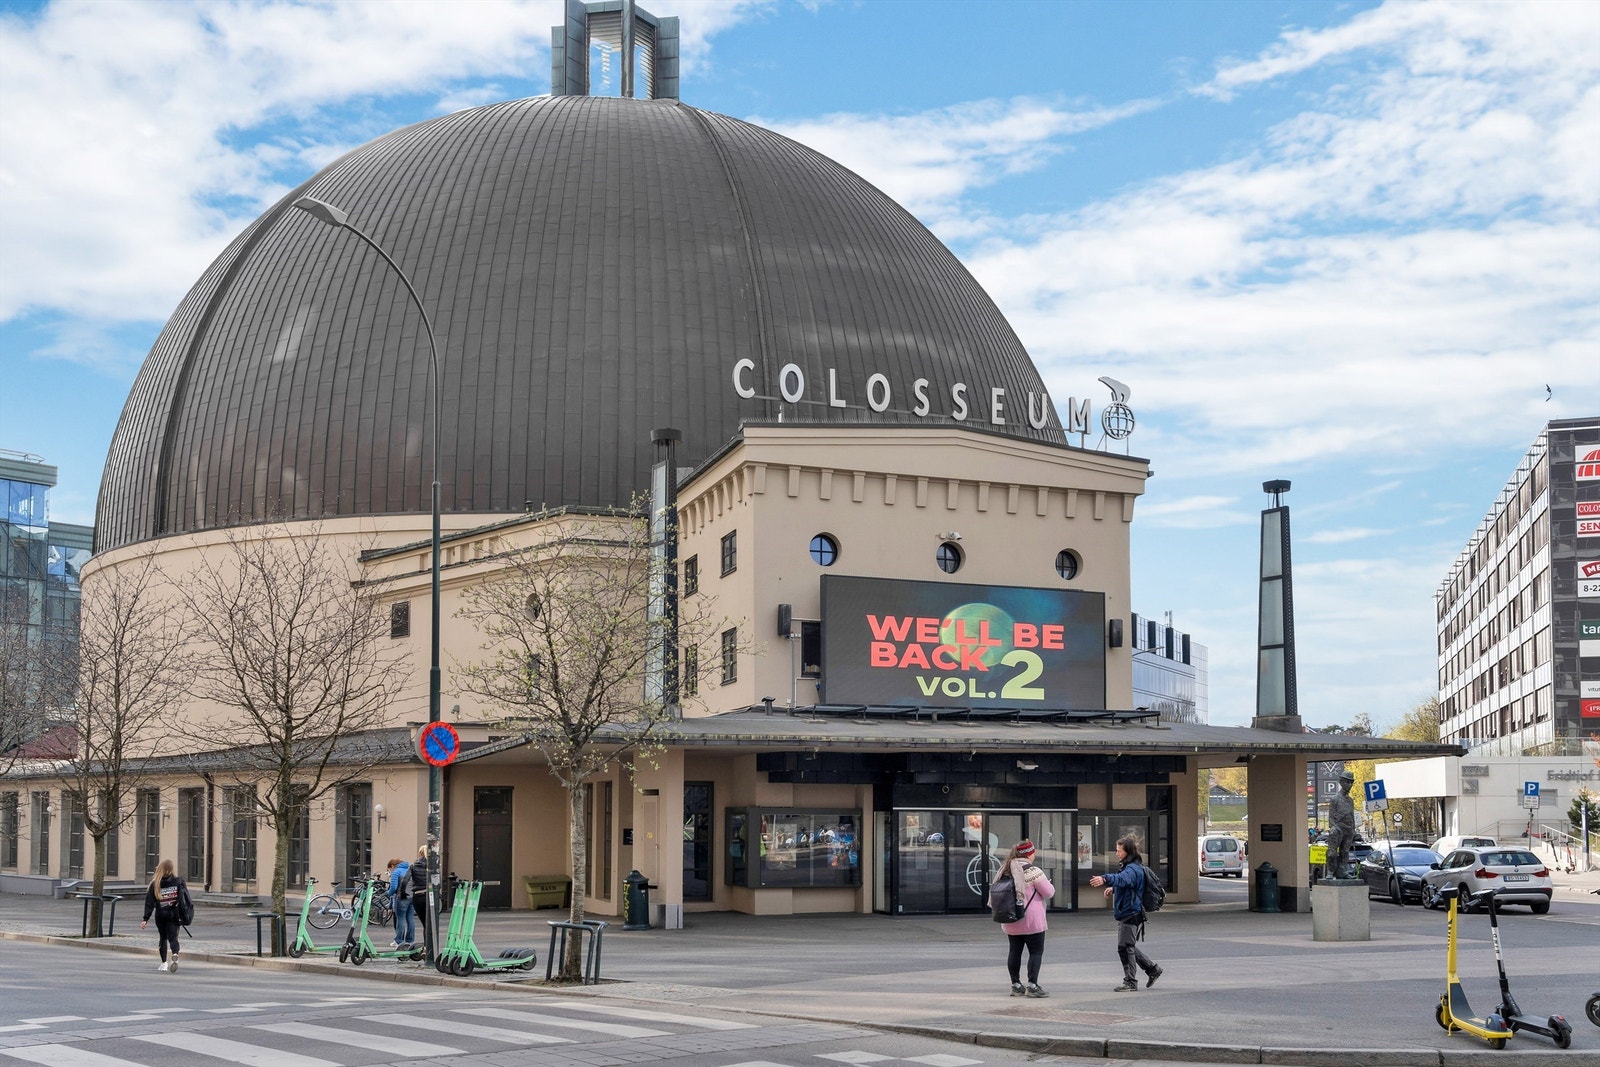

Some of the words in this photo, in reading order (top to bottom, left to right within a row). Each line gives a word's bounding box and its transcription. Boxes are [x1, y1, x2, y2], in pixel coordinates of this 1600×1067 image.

[732, 358, 1091, 435] COLOSSEUM
[1013, 622, 1065, 650] BE
[870, 641, 989, 672] BACK
[915, 675, 997, 699] VOL.
[1000, 649, 1045, 701] 2
[1328, 782, 1335, 792] P
[1368, 783, 1380, 799] P
[1527, 783, 1536, 794] P
